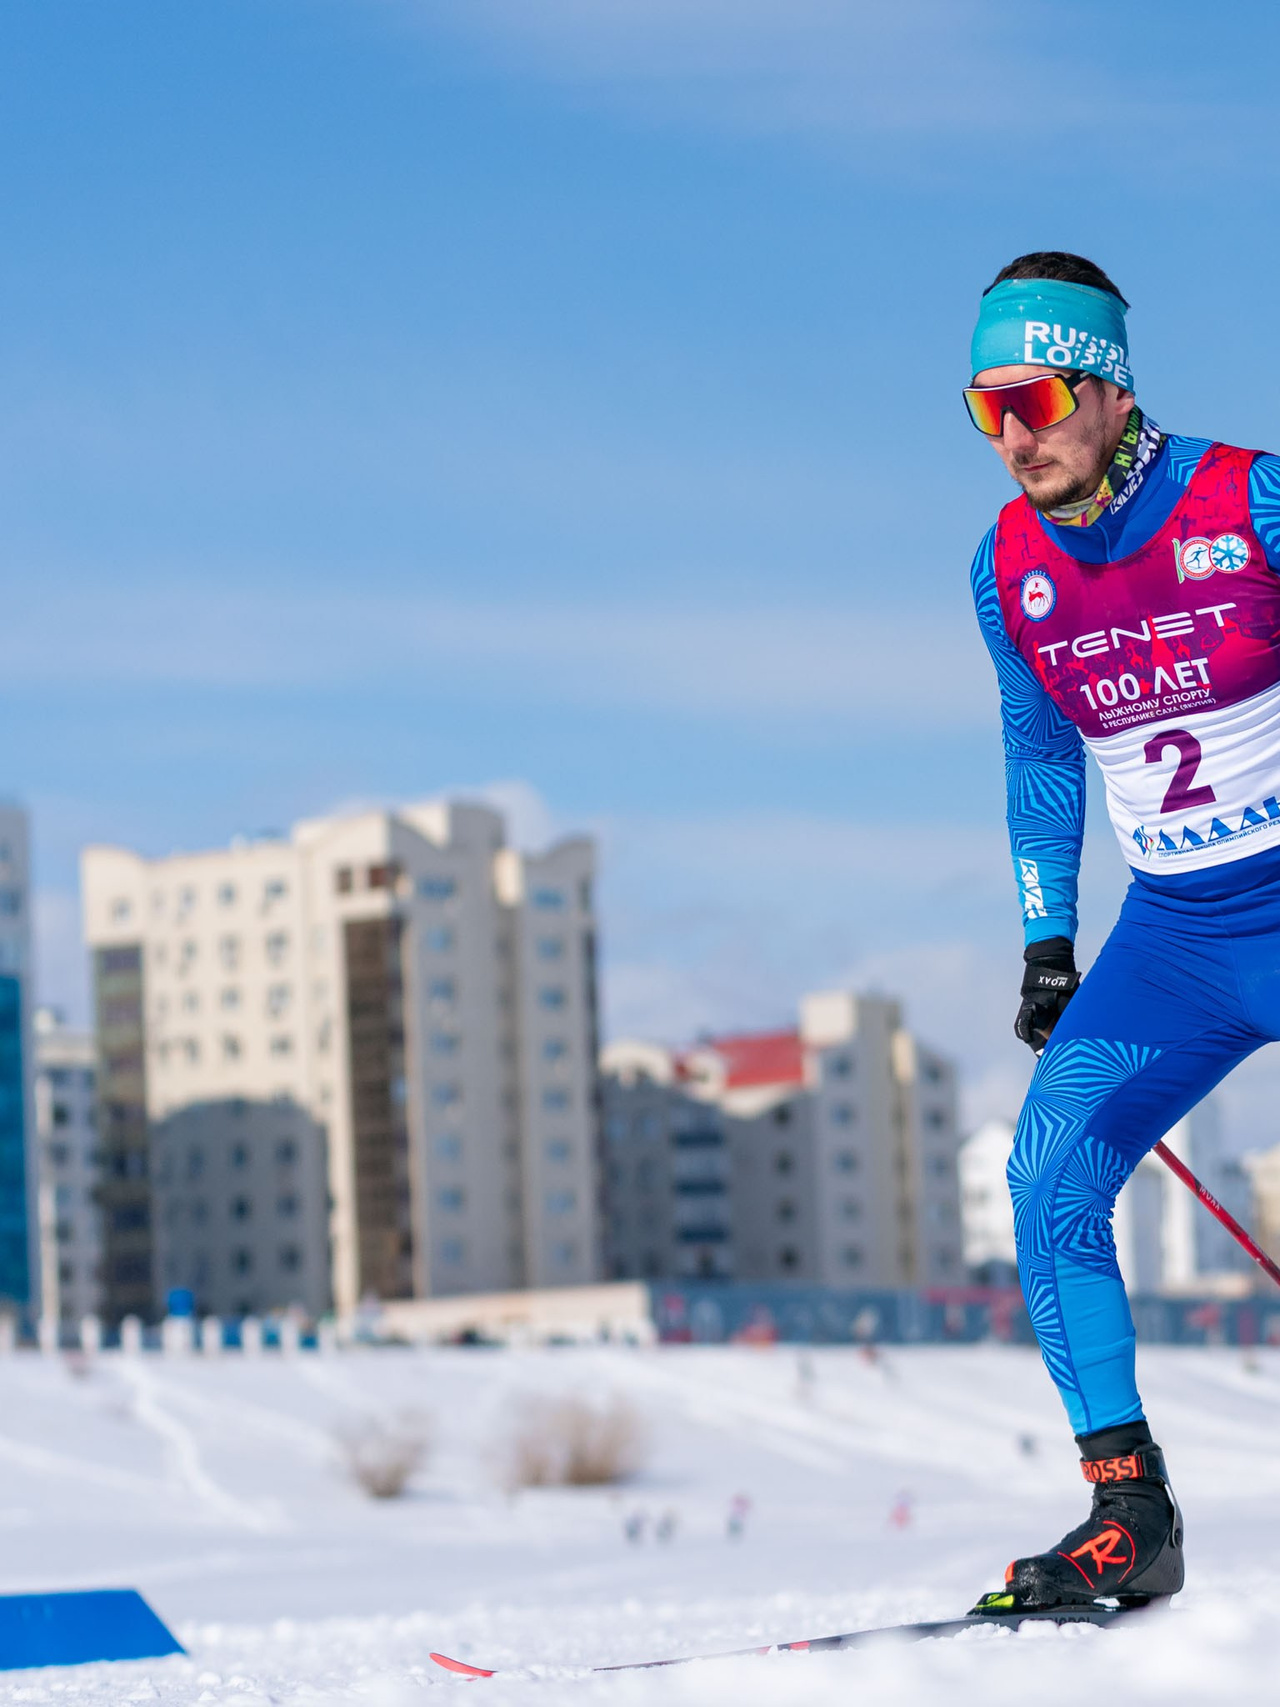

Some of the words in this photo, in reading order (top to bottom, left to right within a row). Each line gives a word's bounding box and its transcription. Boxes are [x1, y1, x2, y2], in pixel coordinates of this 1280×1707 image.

[1037, 602, 1237, 666] TENET
[1080, 673, 1141, 710] 100
[1154, 657, 1210, 694] ЛЕТ
[1098, 698, 1160, 721] ЛЫЖНОМУ
[1163, 689, 1211, 706] СПОРТУ
[1109, 710, 1156, 728] РЕСПУБЛИКЕ
[1155, 706, 1179, 716] САХА
[1143, 729, 1217, 814] 2
[1217, 824, 1268, 846] ОЛИМПИЙСКОГО
[1038, 975, 1067, 987] MOAX
